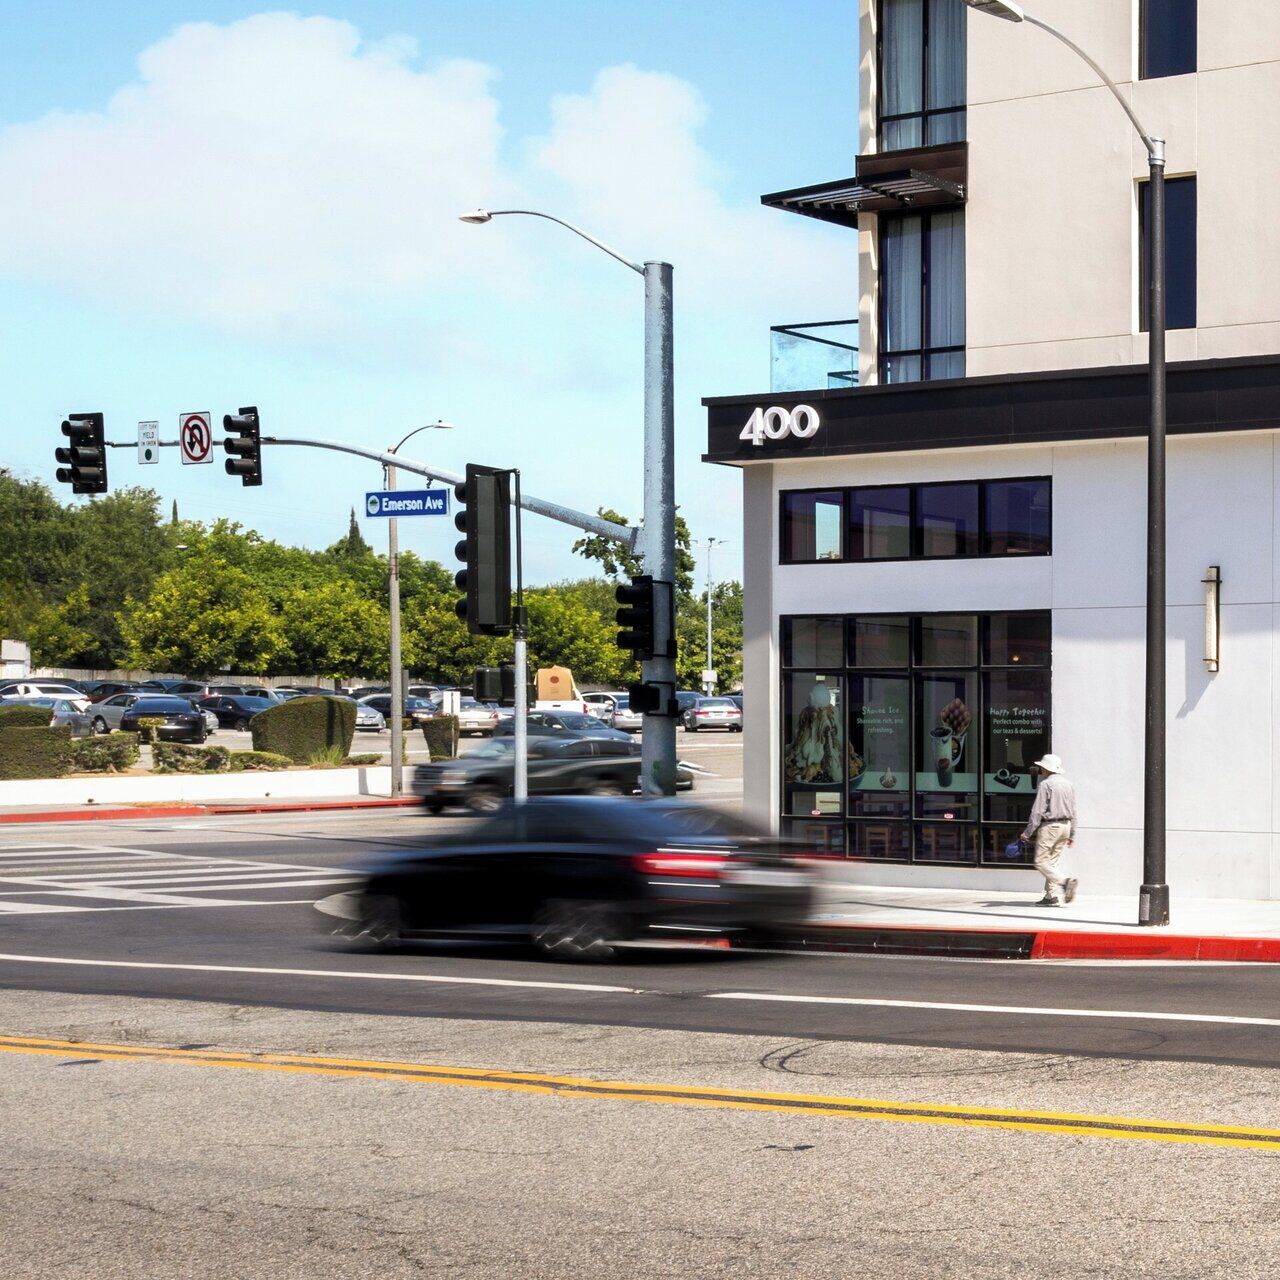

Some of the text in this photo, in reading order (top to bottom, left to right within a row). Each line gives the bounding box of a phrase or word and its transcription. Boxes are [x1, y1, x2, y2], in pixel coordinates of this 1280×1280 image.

[739, 404, 820, 445] 400
[142, 431, 154, 439] YIELD
[382, 496, 444, 511] Emerson Ave
[990, 707, 1045, 716] Happy Together
